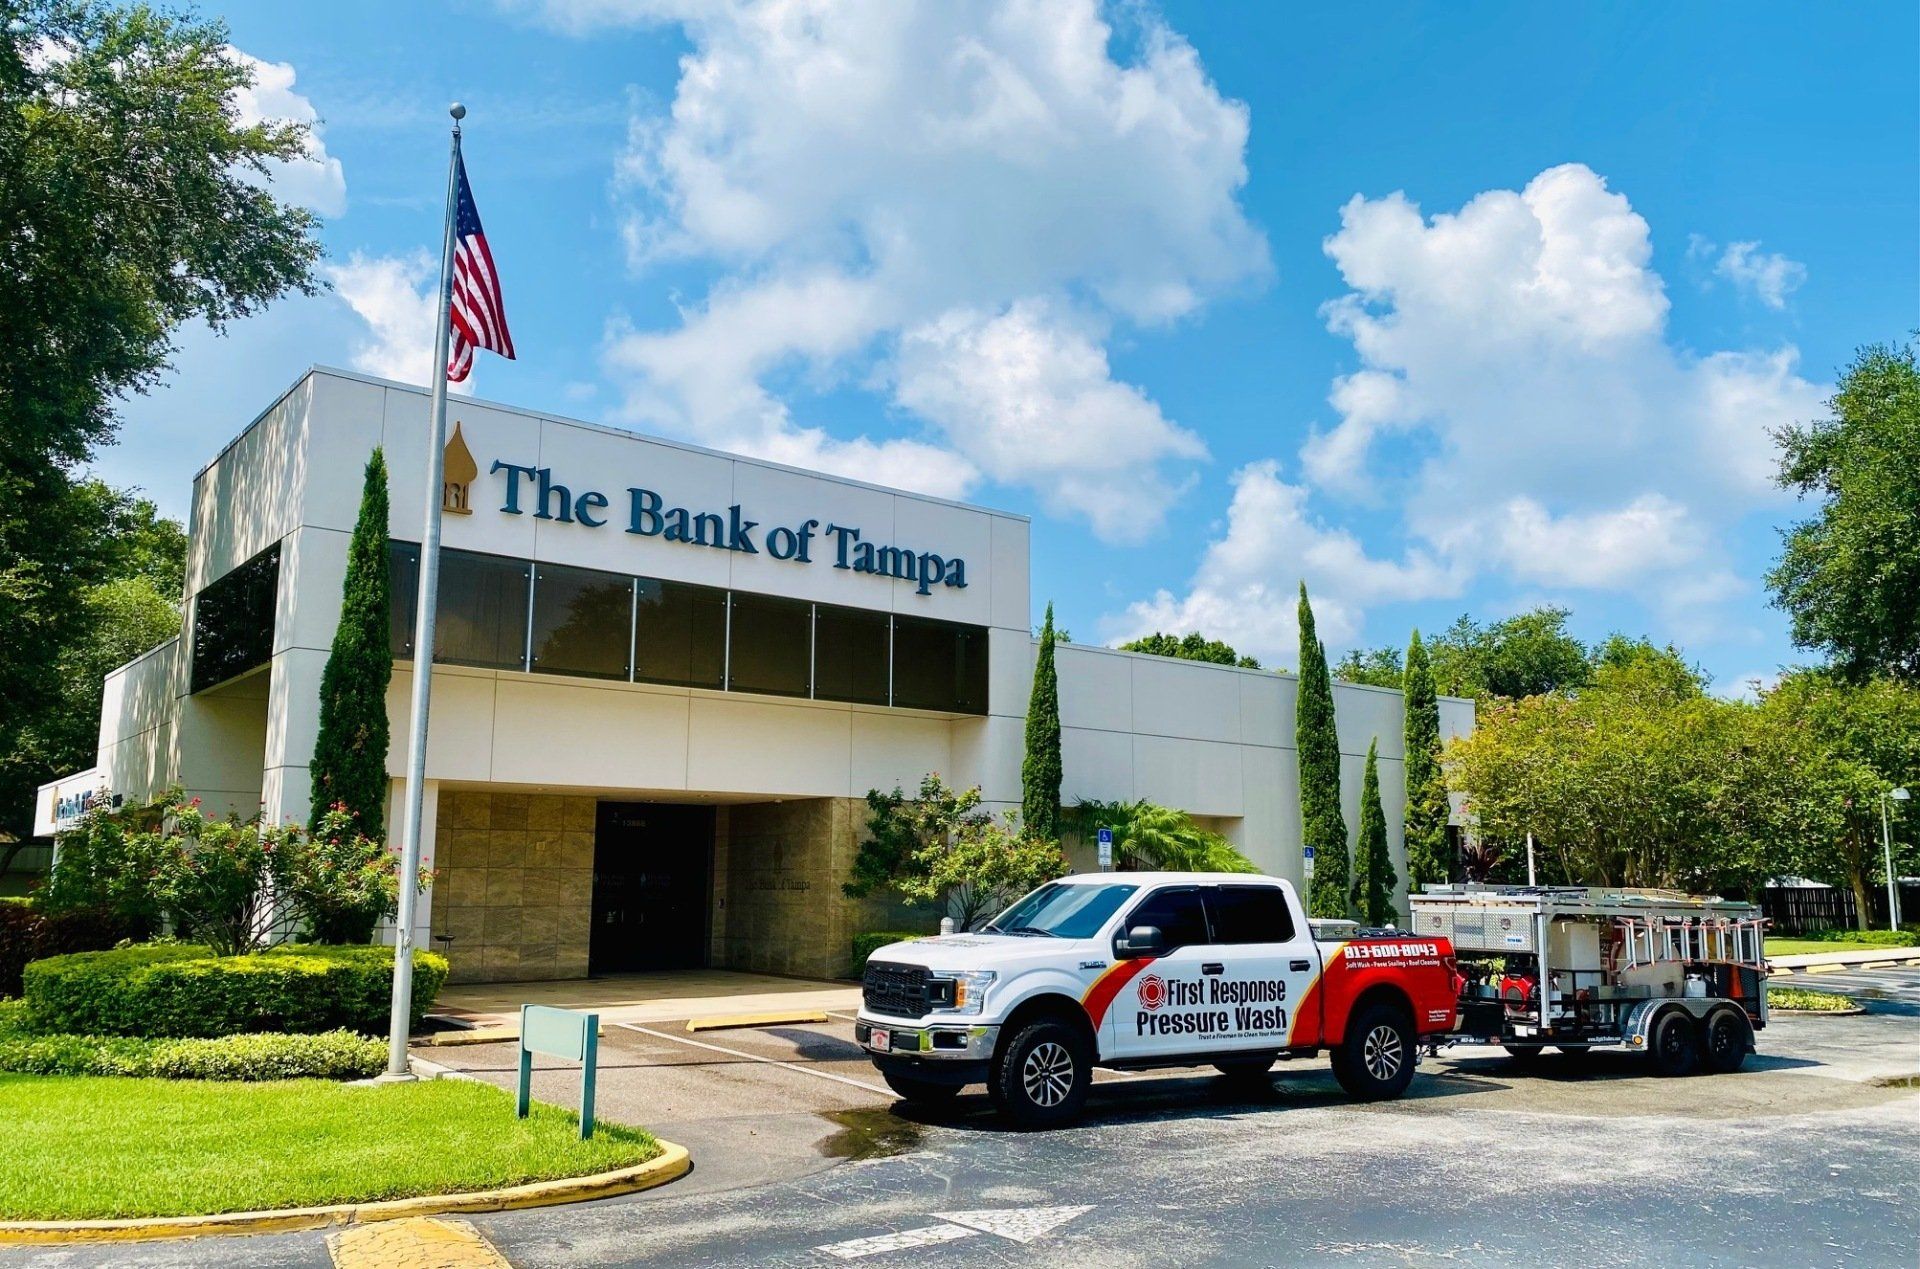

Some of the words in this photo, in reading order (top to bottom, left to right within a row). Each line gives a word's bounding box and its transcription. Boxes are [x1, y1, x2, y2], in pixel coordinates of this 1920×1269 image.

[490, 459, 608, 528] The
[625, 487, 759, 554] Bank
[766, 519, 818, 563] of
[825, 522, 968, 595] Tampa
[1343, 944, 1438, 959] 813-600-8043
[1420, 959, 1440, 967] Cleaning
[1167, 978, 1205, 1006] First
[1210, 978, 1286, 1006] Response
[1136, 1011, 1229, 1036] Pressure
[1235, 1006, 1287, 1031] Wash
